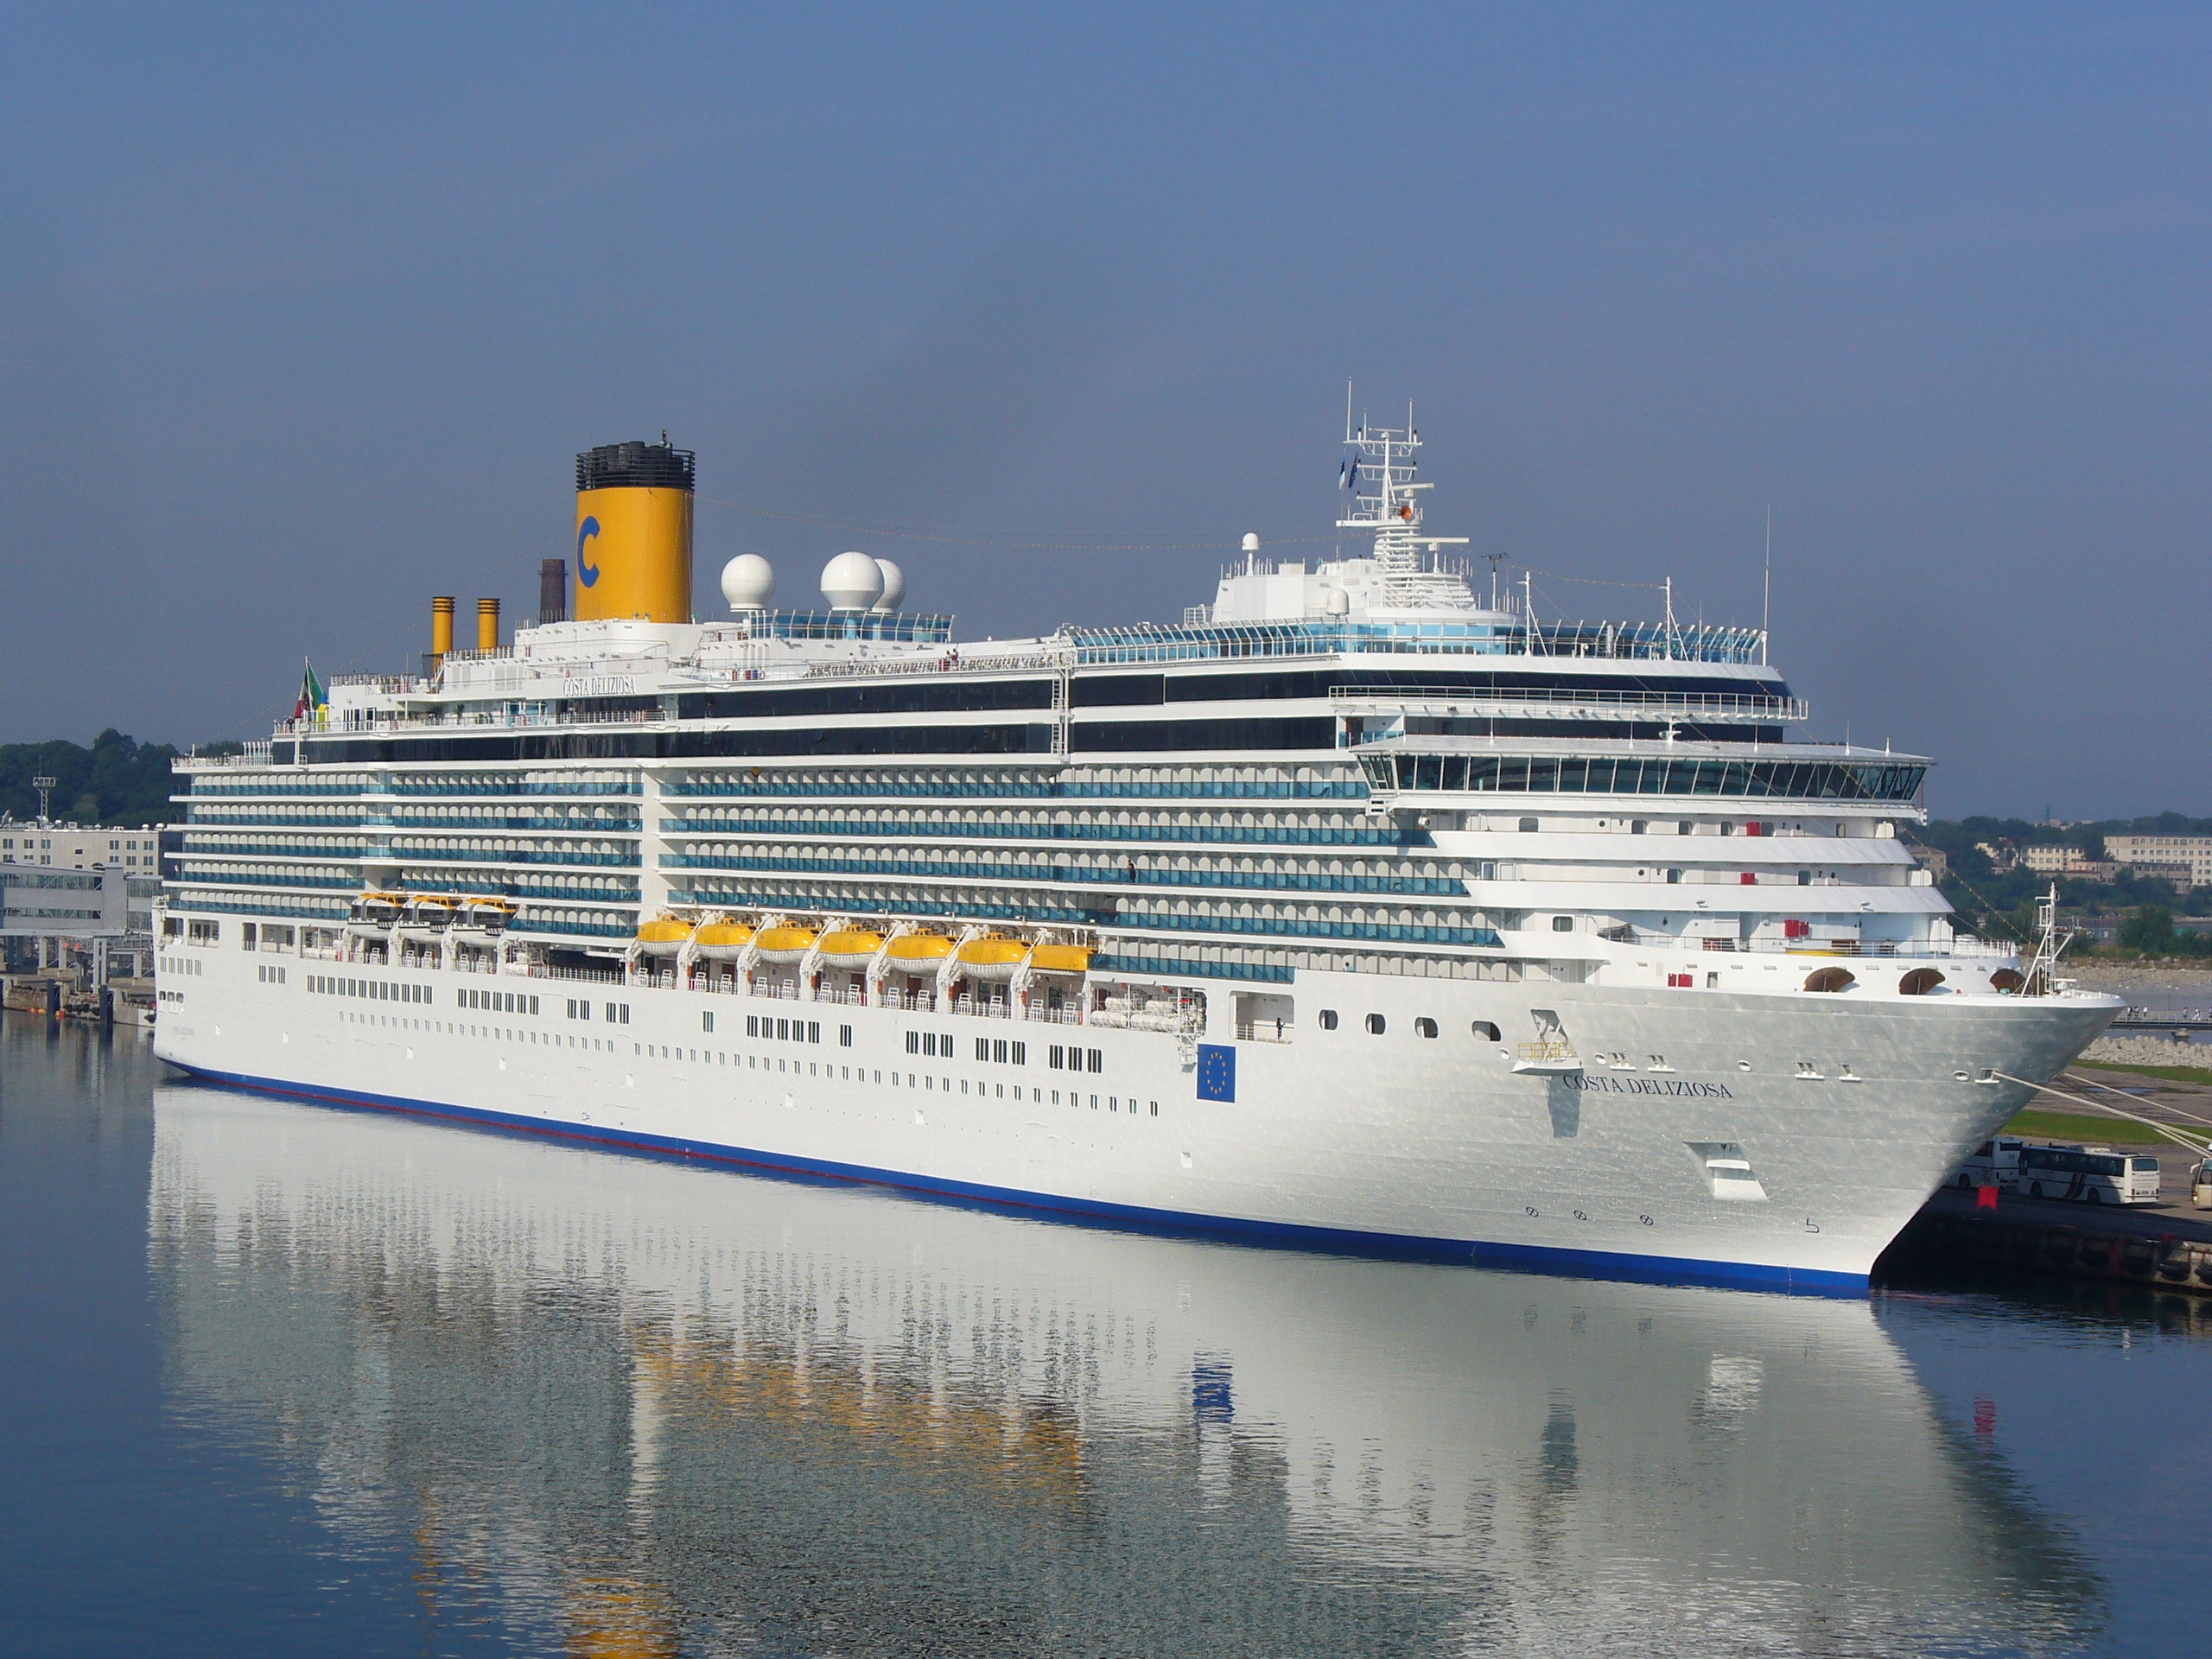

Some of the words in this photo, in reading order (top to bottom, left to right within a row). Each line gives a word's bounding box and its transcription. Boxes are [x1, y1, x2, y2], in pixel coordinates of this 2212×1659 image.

[577, 516, 601, 588] C
[563, 678, 590, 696] COSTA
[591, 676, 636, 696] DELIZIOSA
[1562, 1074, 1624, 1094] COSTA
[1625, 1077, 1735, 1099] DELIZIOSA
